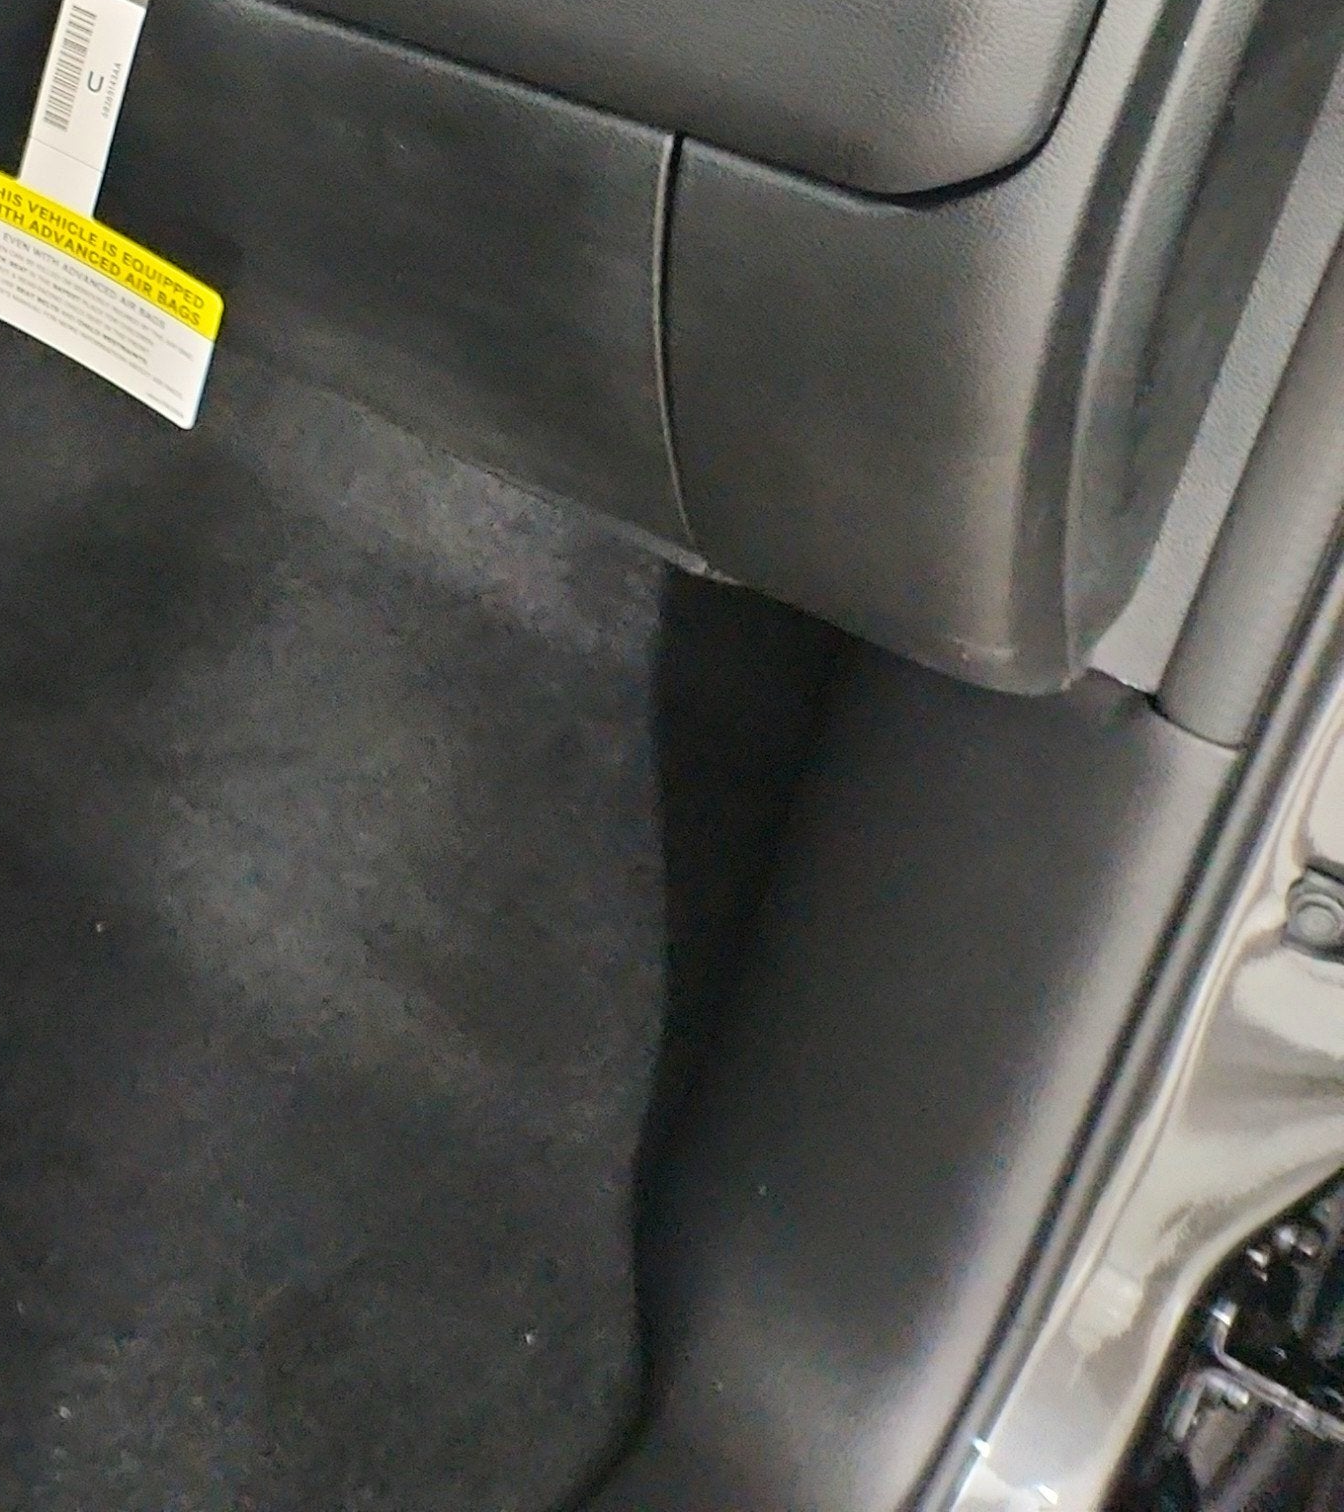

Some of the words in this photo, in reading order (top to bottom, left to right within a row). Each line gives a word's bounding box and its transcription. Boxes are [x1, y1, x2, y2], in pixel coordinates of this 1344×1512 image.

[2, 230, 31, 253] EVEN
[31, 246, 59, 268] WITH
[26, 199, 98, 247] VEHICLE
[101, 239, 118, 258] IS
[121, 250, 205, 311] EQUIPPED
[28, 217, 121, 278] ADVANCED
[123, 270, 154, 297] AIR
[156, 289, 202, 327] BAGS
